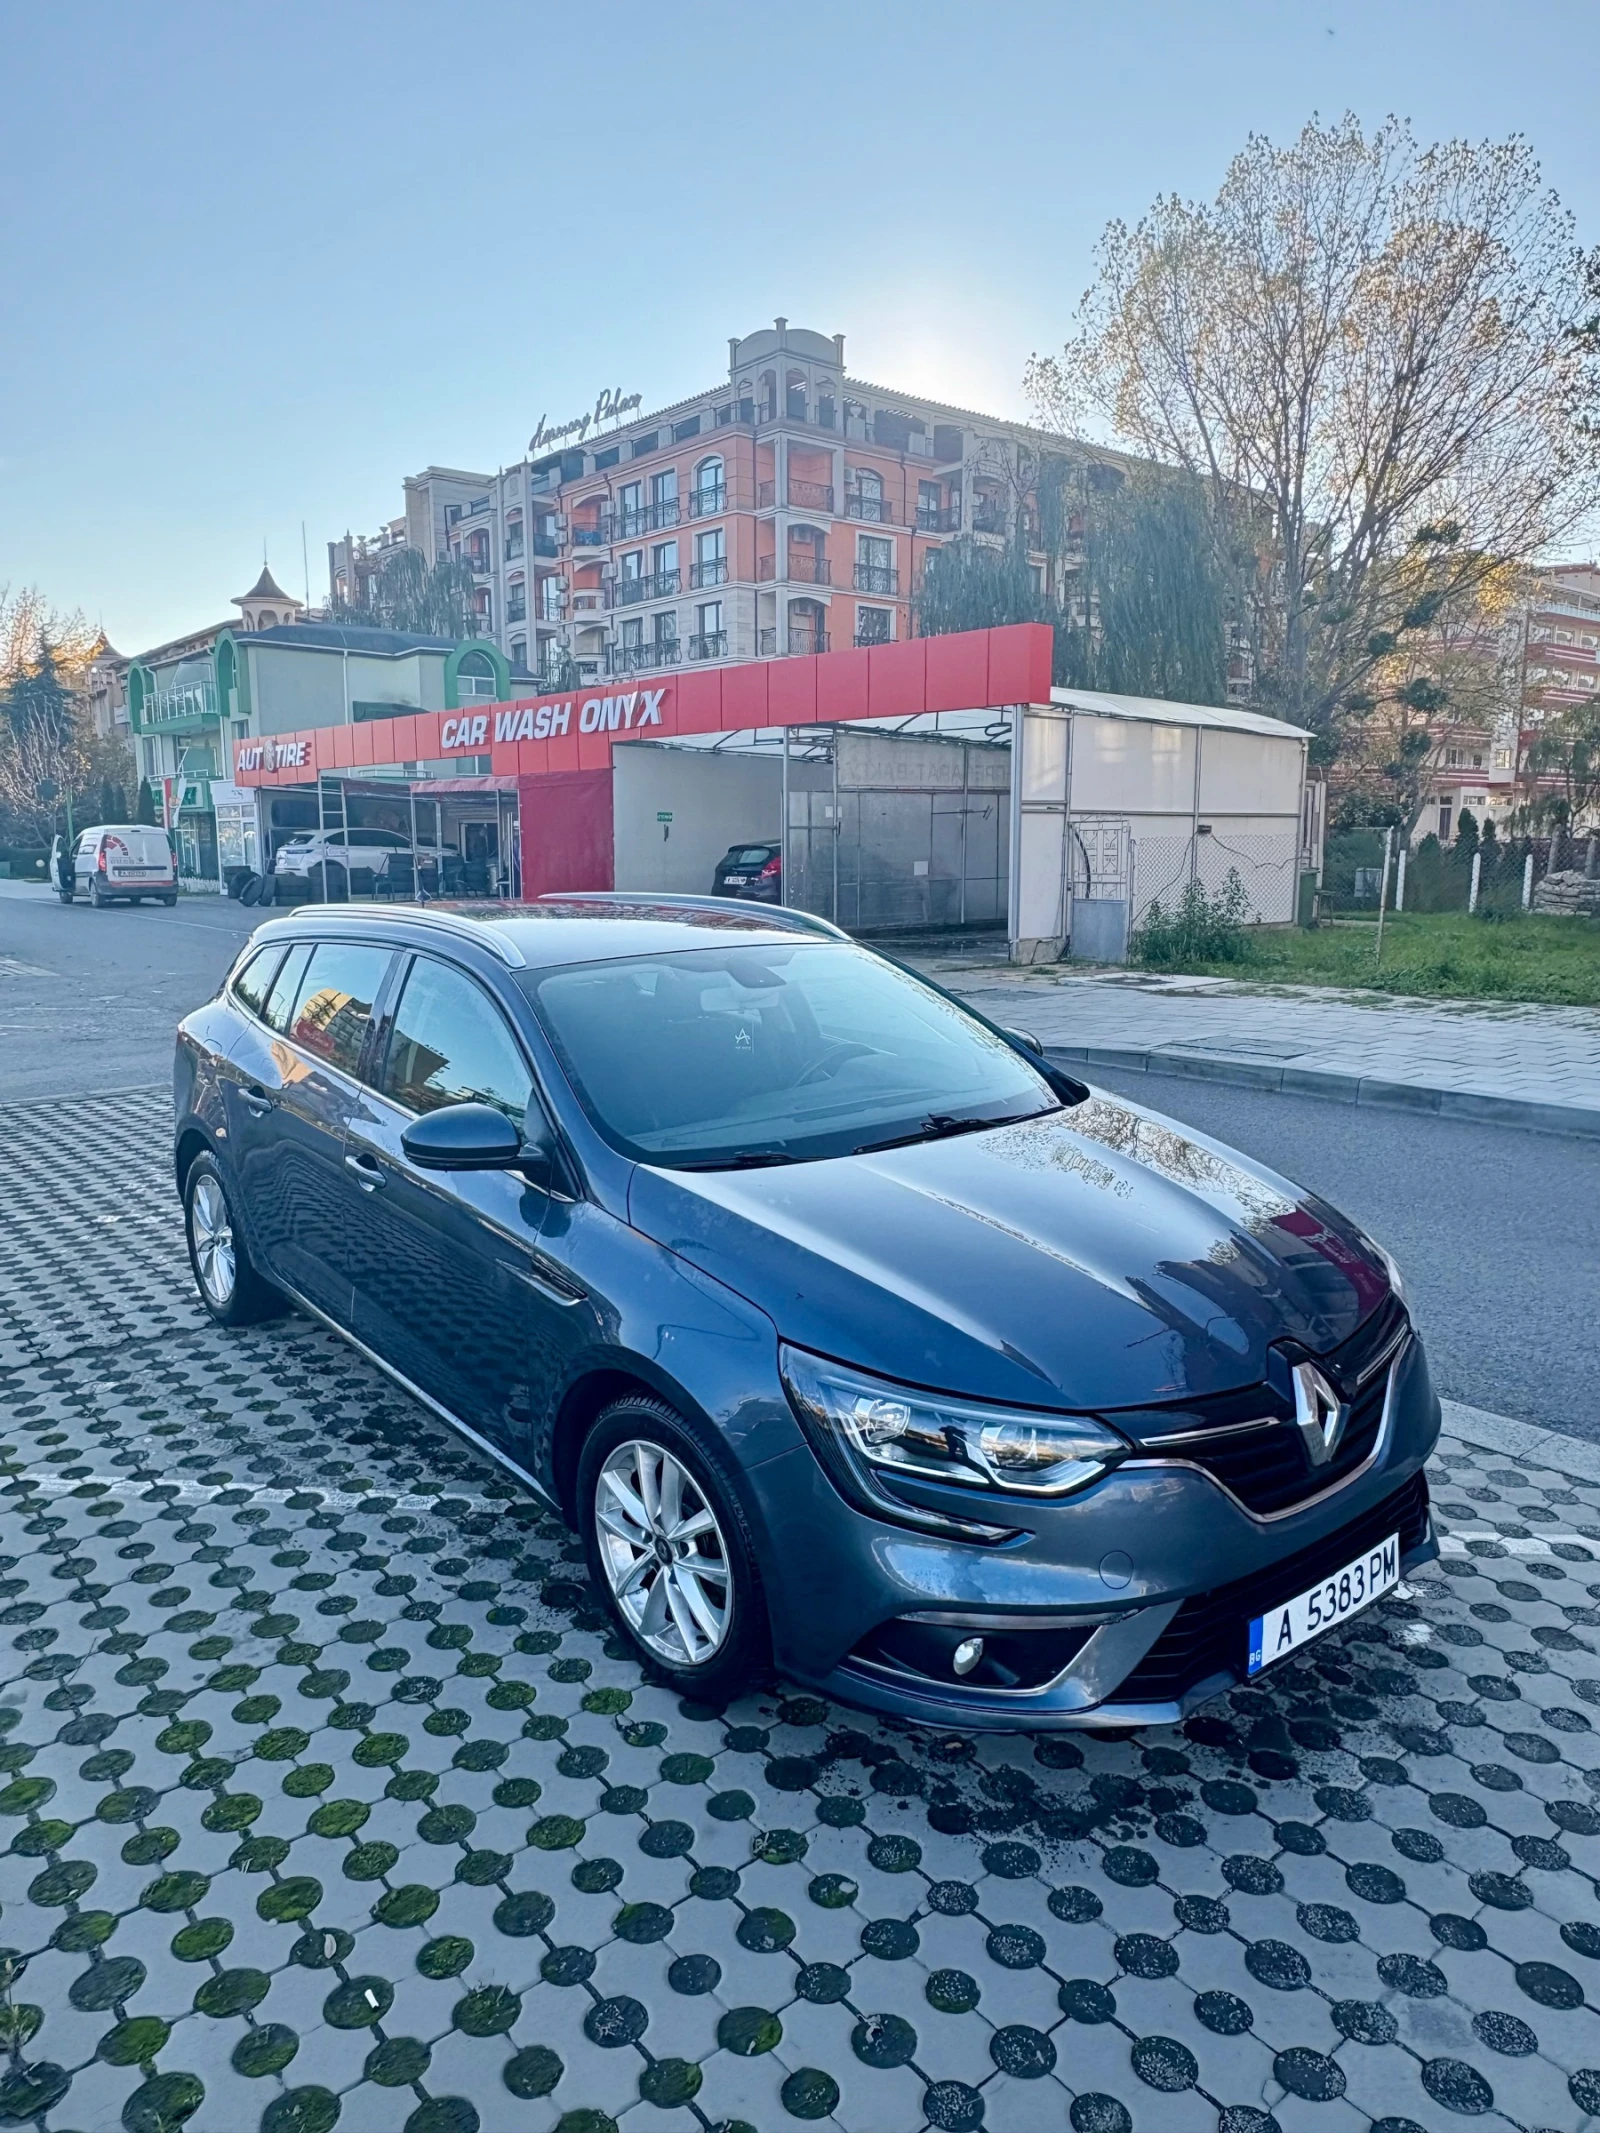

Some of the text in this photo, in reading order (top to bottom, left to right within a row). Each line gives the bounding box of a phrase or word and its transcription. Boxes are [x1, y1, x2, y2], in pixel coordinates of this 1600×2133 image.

[441, 688, 666, 749] CAR WASH ONYX
[1276, 1540, 1395, 1651] A 5383 PM
[1249, 1649, 1261, 1666] BG
